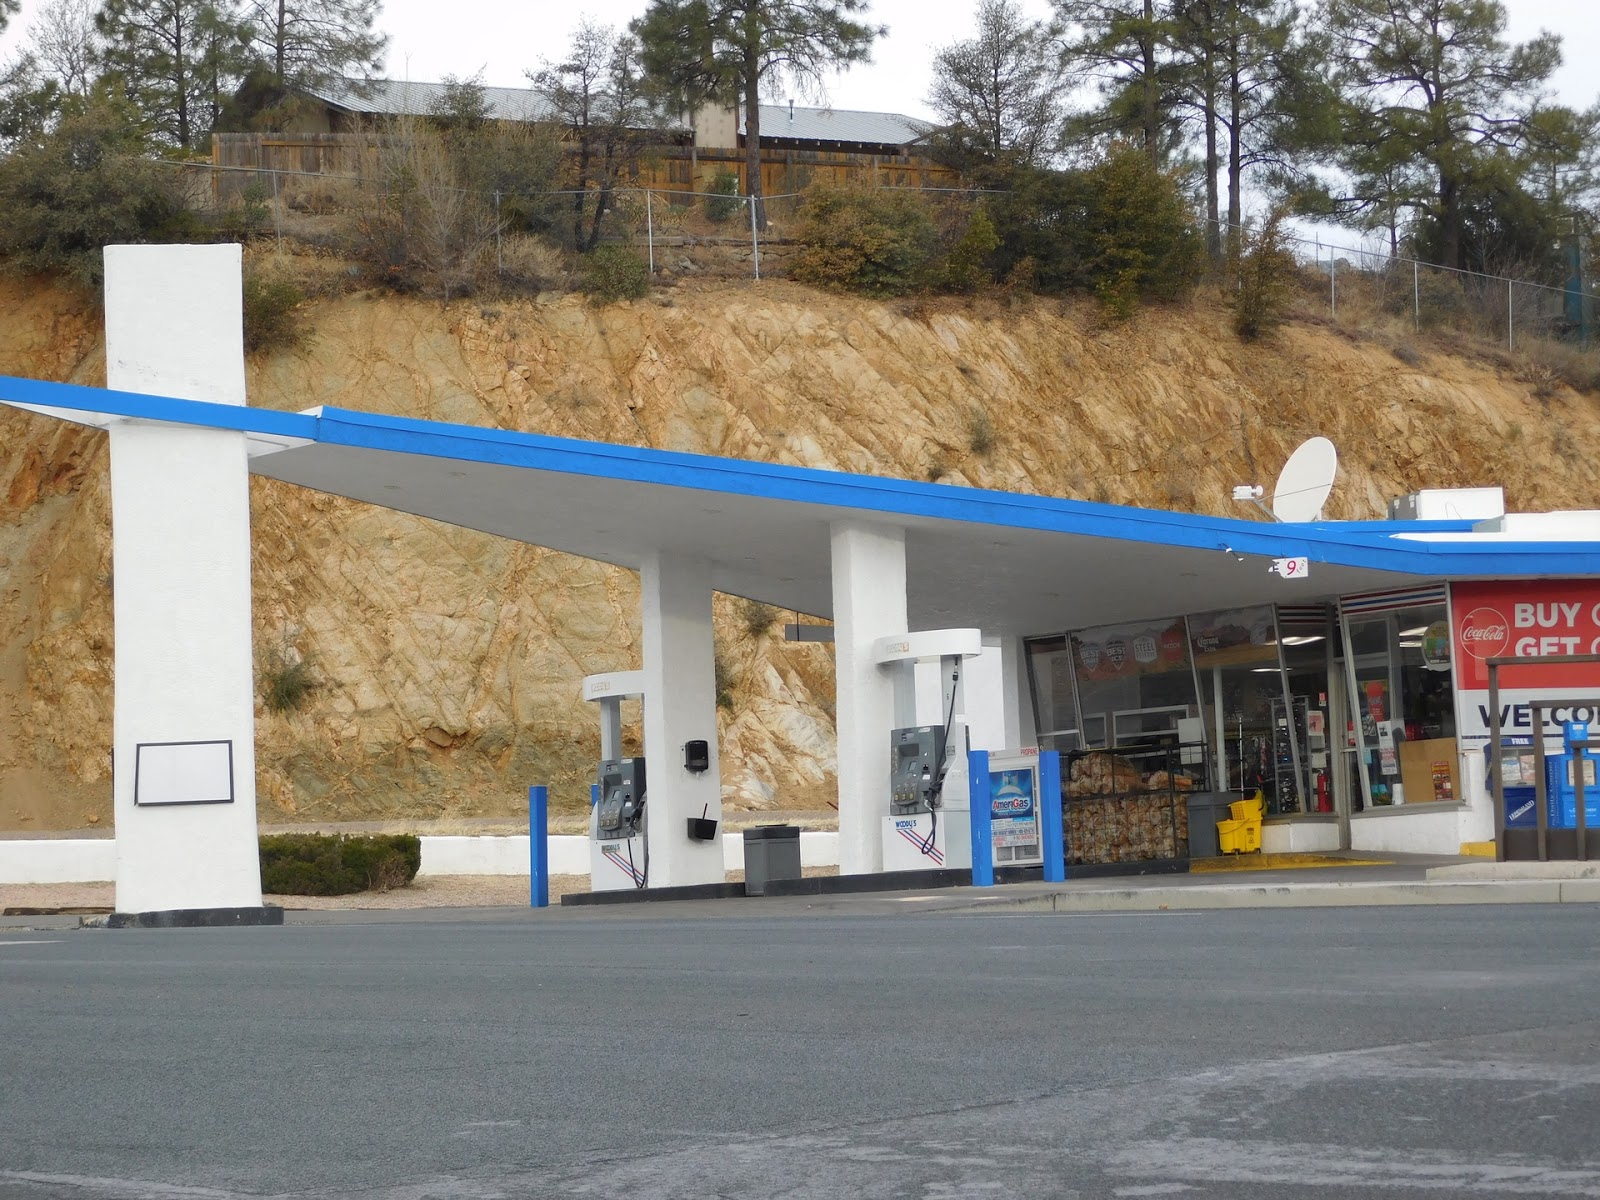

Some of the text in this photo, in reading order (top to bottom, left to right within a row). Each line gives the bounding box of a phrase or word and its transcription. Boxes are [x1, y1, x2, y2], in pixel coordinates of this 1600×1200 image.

[1287, 560, 1297, 576] 9
[1514, 602, 1582, 628] BUY
[1107, 647, 1126, 657] BEST
[1134, 642, 1156, 652] STEEL
[1514, 636, 1581, 657] GET
[1080, 649, 1099, 659] BEST
[992, 799, 1029, 810] AmeriGas
